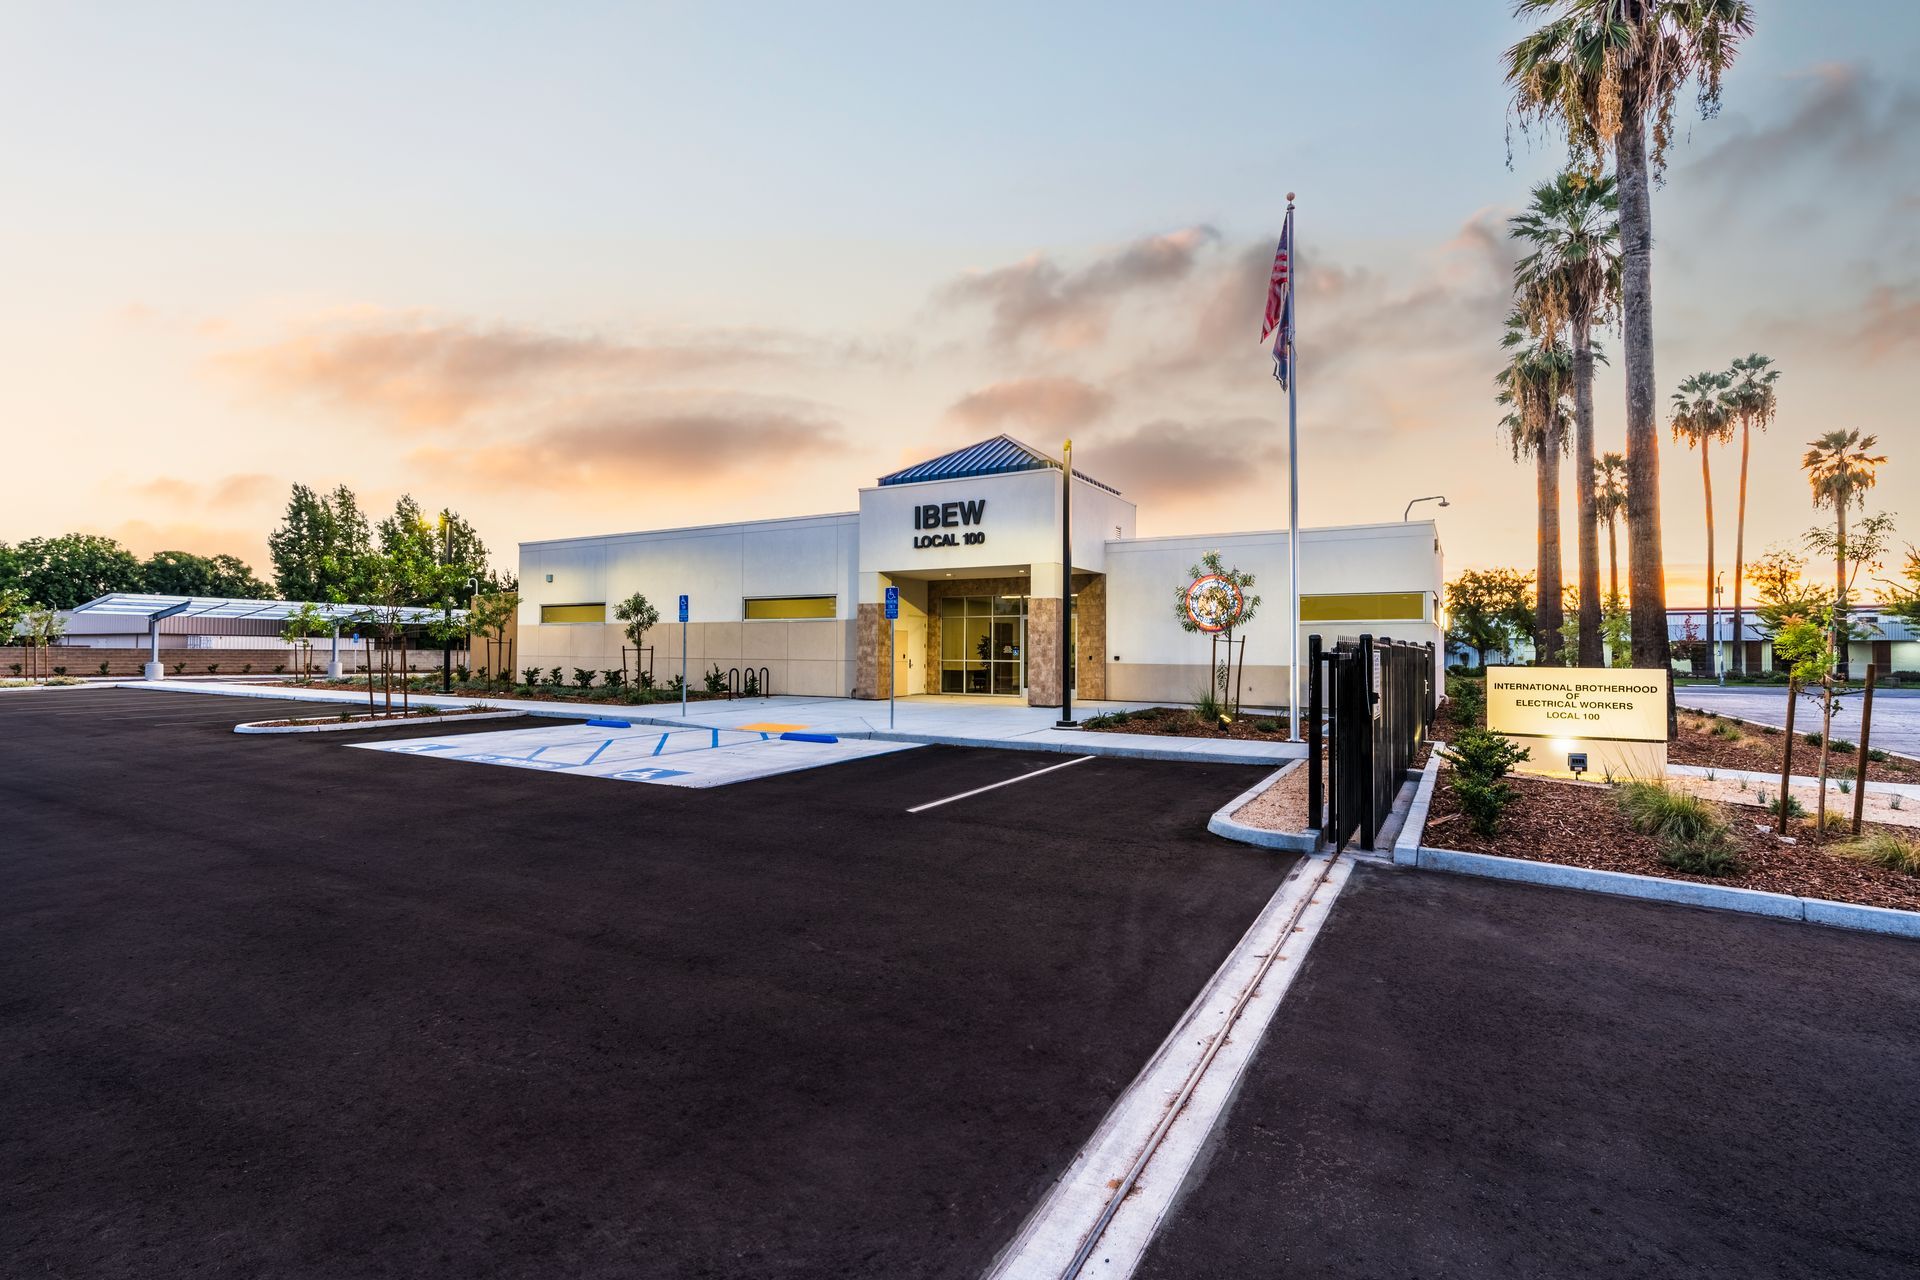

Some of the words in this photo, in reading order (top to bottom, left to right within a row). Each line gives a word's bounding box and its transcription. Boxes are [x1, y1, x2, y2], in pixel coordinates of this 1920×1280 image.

[914, 500, 986, 530] IBEW
[914, 534, 960, 549] LOCAL
[963, 532, 986, 545] 100
[1494, 682, 1572, 692] INTERNATIONAL
[1575, 684, 1658, 694] BROTHERHOOD
[1565, 692, 1580, 700] OF
[1515, 699, 1577, 709] ELECTRICAL
[1579, 701, 1634, 710] WORKERS
[1546, 711, 1580, 720] LOCAL
[1583, 713, 1600, 721] 100
